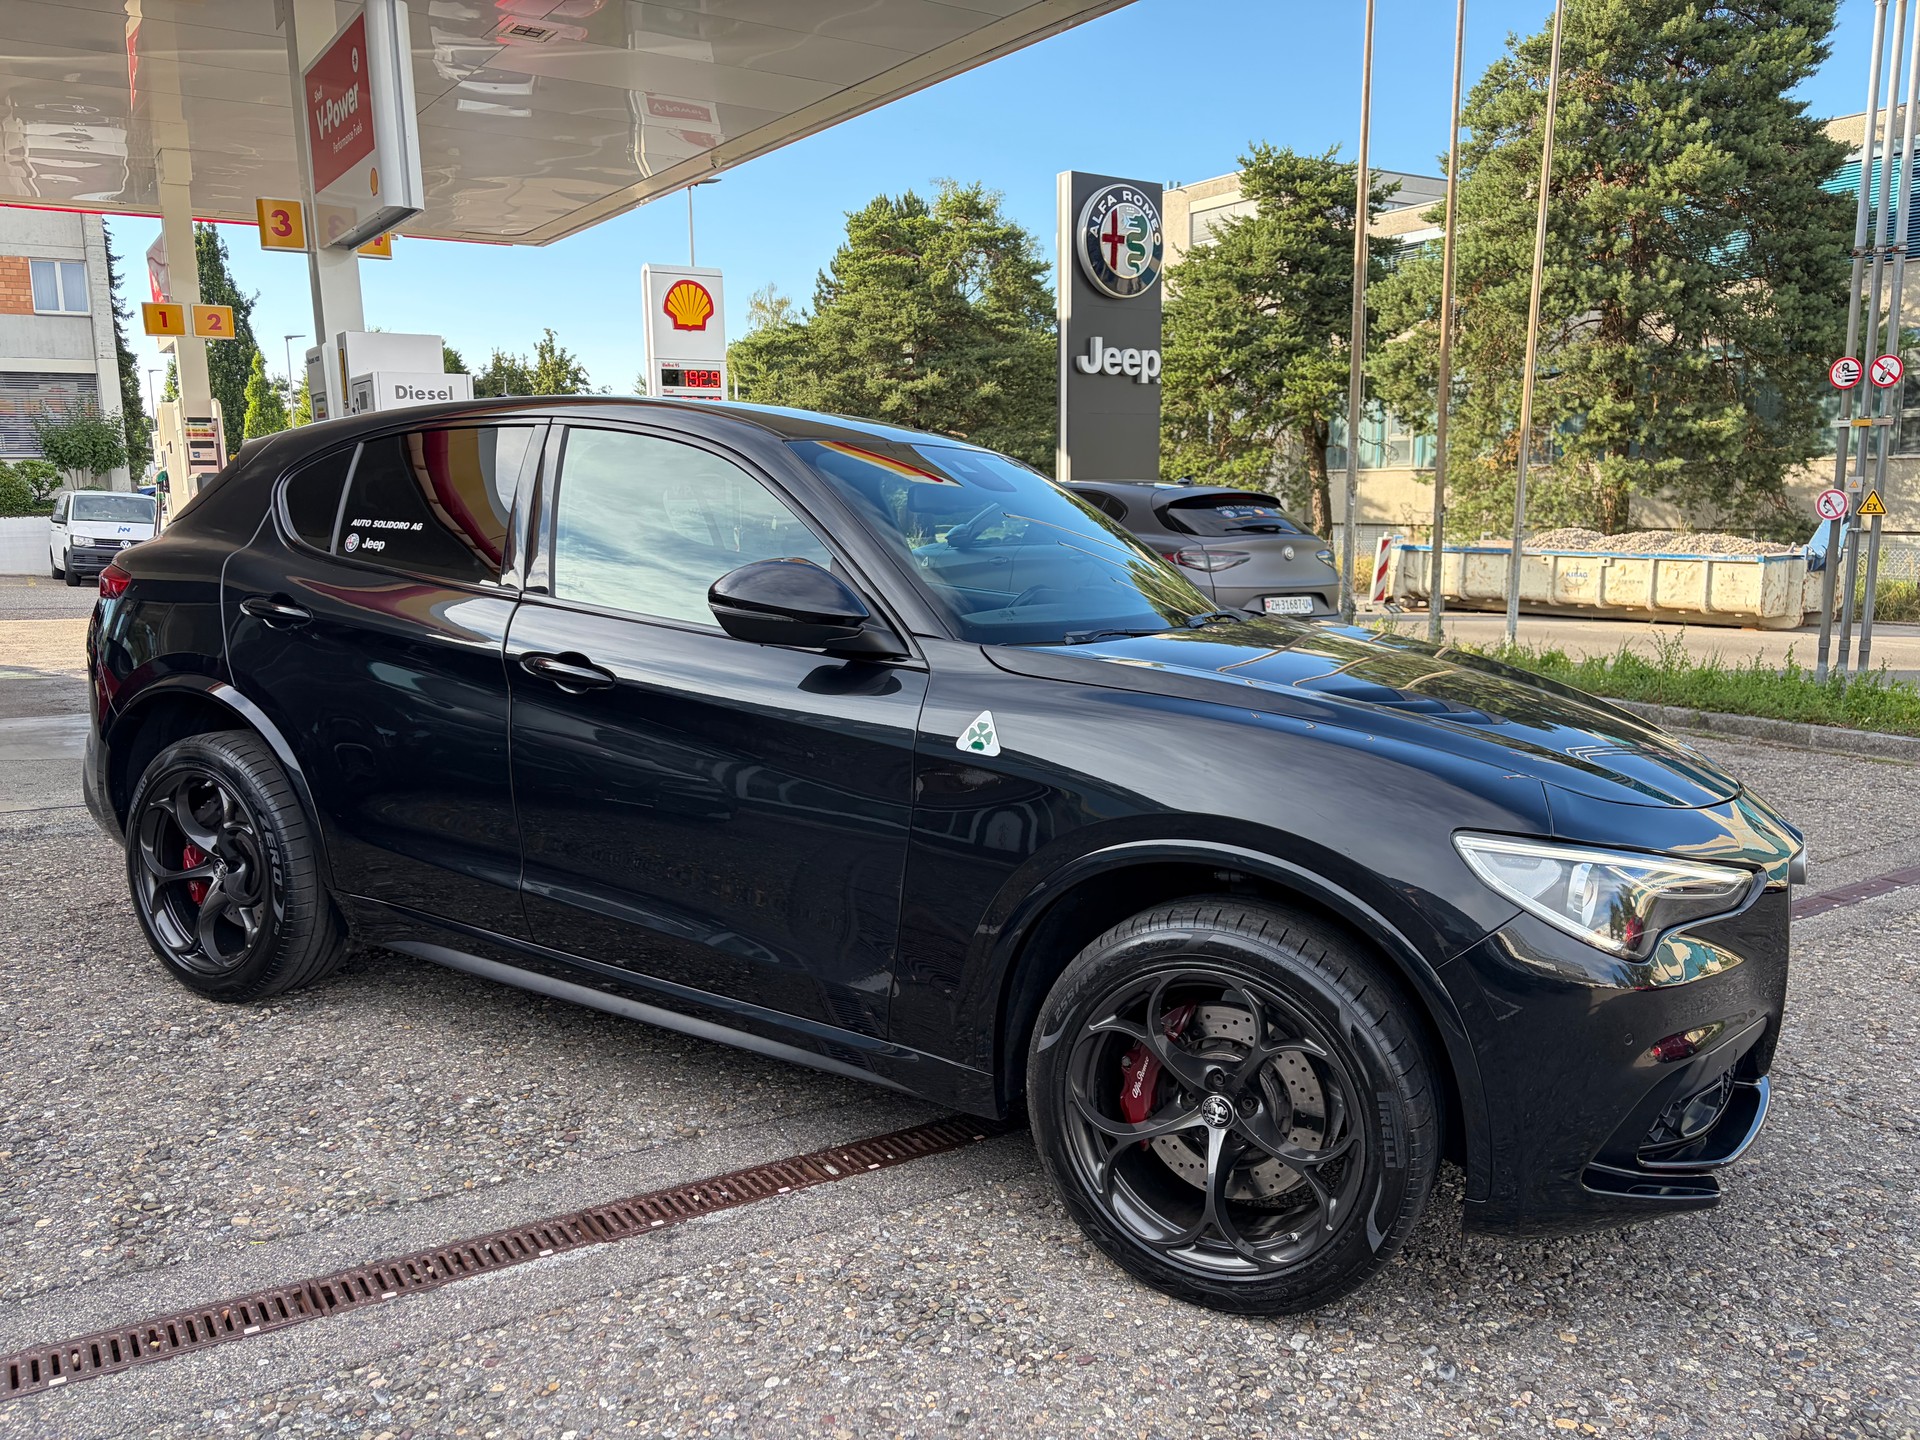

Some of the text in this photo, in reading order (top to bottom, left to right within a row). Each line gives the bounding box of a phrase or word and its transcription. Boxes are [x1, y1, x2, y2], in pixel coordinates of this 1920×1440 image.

[315, 81, 359, 140] V-Power
[270, 209, 293, 237] 3
[1089, 190, 1162, 246] ALFA ROMEO
[158, 310, 168, 328] 1
[206, 313, 223, 331] 2
[1076, 336, 1162, 384] Jeep
[394, 384, 453, 401] Diesel
[1866, 502, 1878, 511] EX
[350, 518, 424, 531] AUTO SOLIDORO AG
[361, 537, 386, 552] Jeep
[257, 814, 283, 888] ZERO
[1131, 1081, 1142, 1099] Alfa
[1376, 1092, 1404, 1168] PIRELLI
